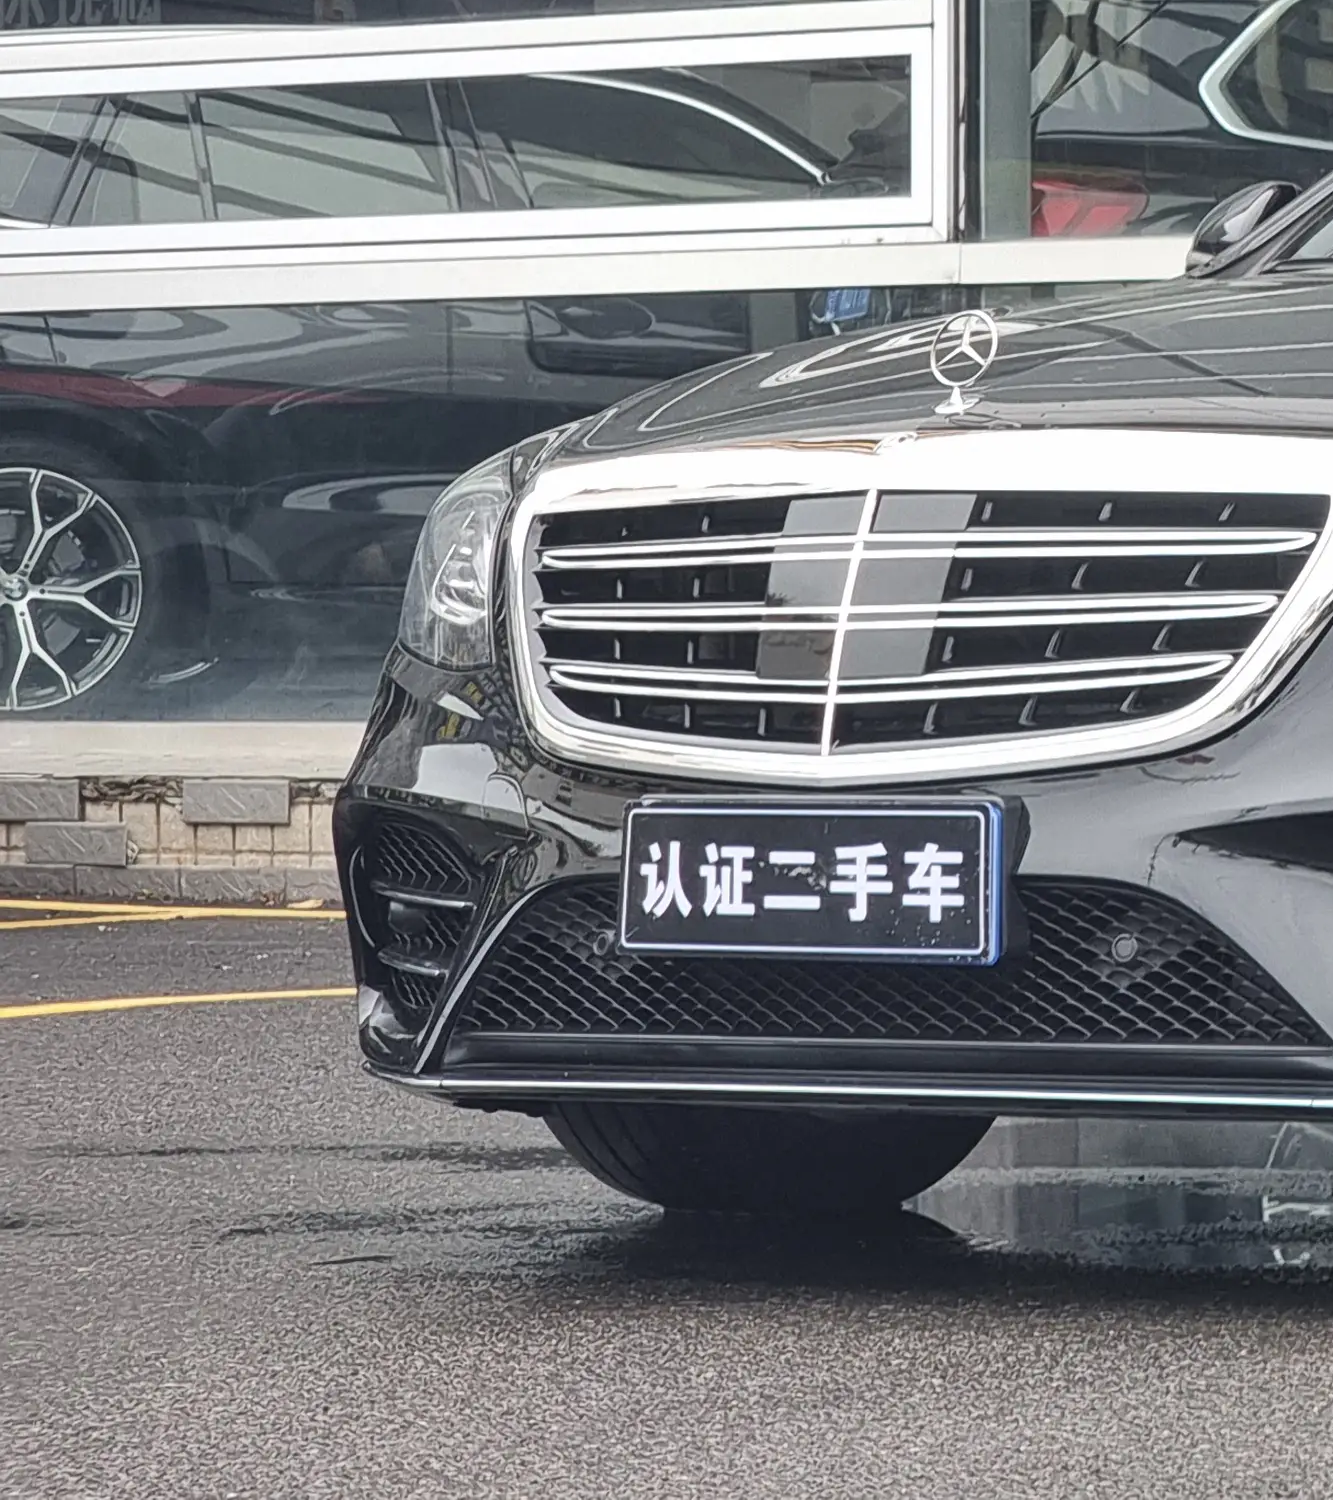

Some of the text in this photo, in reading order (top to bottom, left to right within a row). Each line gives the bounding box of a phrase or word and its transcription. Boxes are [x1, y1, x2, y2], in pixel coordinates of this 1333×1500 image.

[638, 839, 966, 925] 认证二手车
